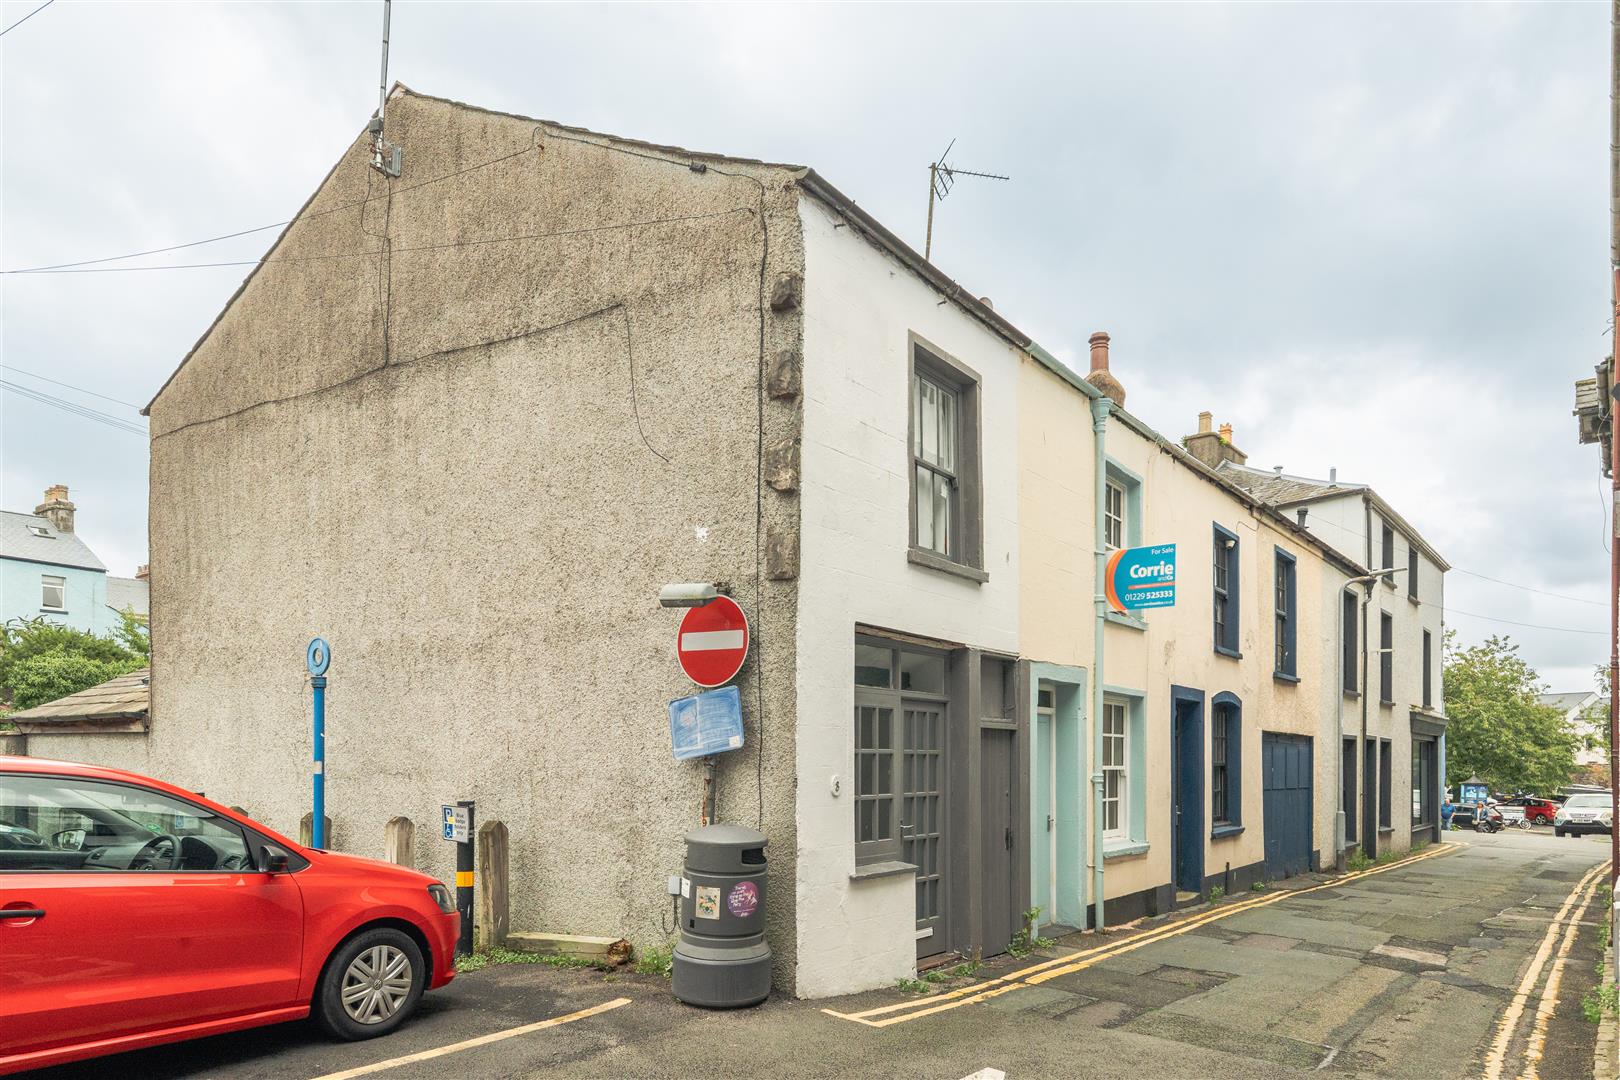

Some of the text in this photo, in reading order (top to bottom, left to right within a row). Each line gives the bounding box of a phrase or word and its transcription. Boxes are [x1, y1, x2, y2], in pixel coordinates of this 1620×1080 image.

[1130, 561, 1173, 578] Corrie
[1124, 590, 1173, 602] 01229 525333
